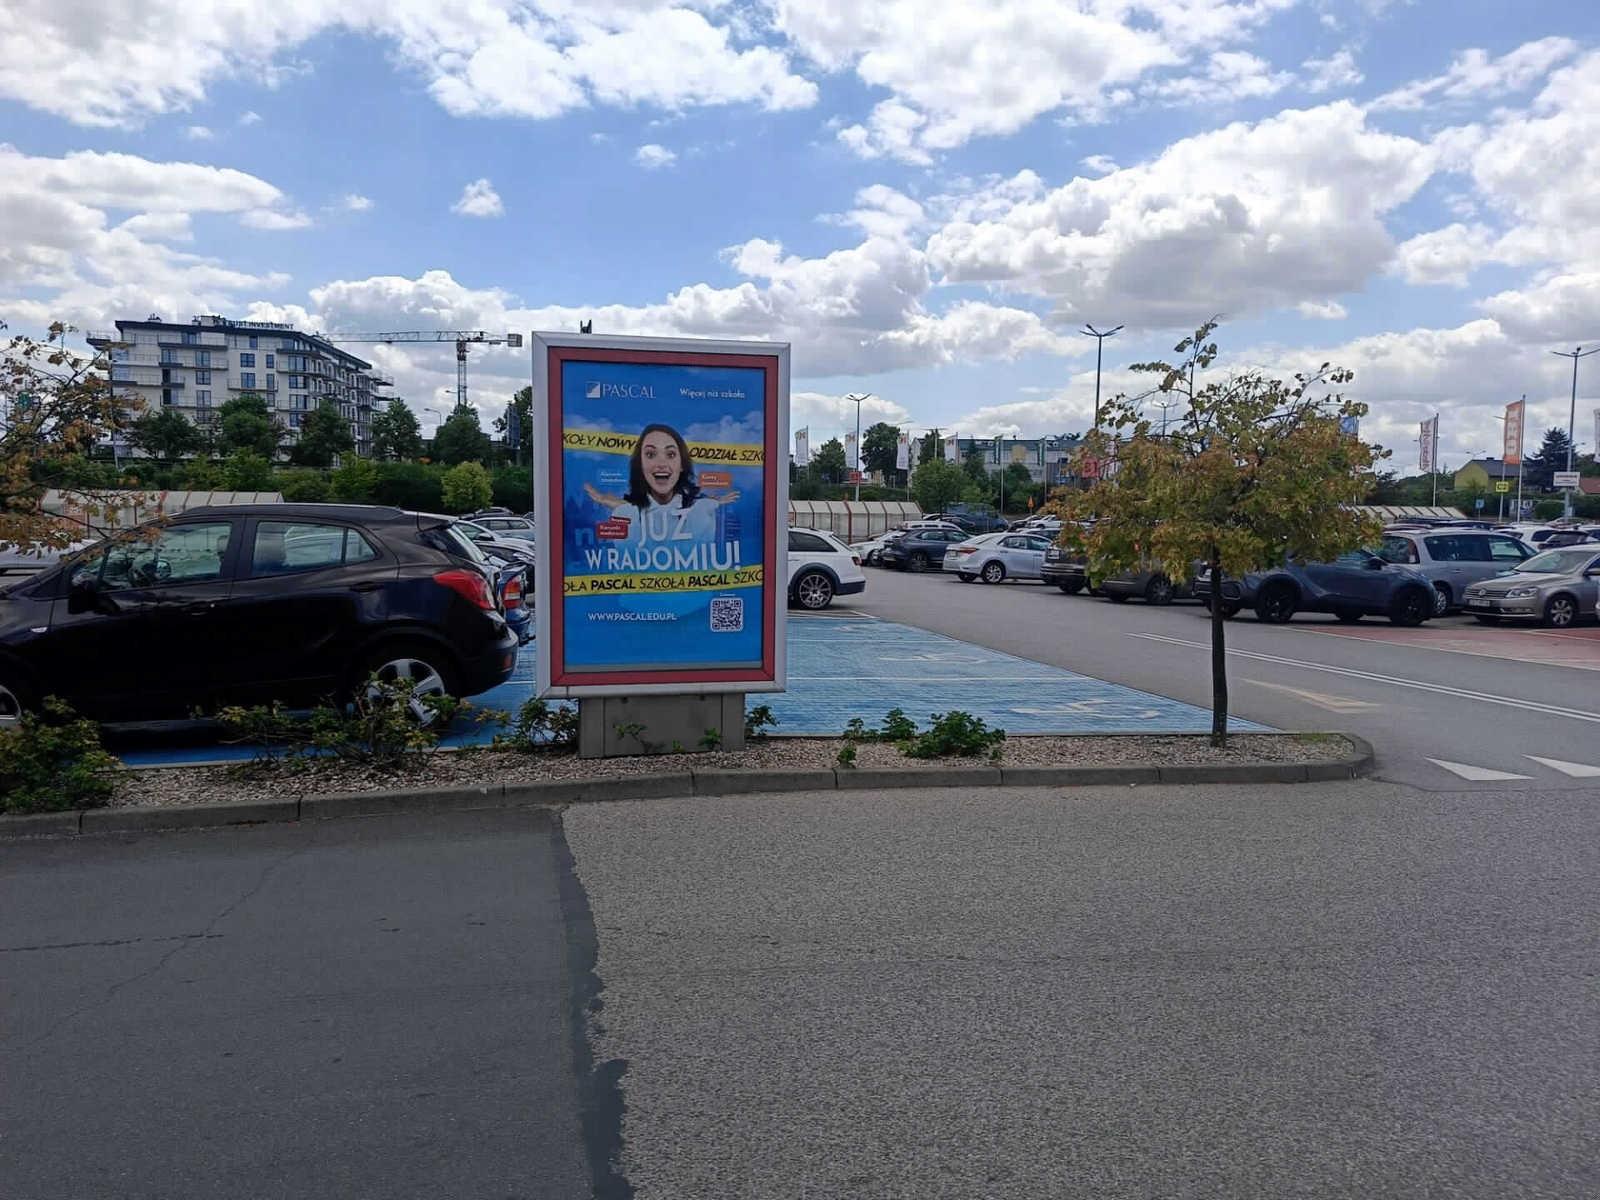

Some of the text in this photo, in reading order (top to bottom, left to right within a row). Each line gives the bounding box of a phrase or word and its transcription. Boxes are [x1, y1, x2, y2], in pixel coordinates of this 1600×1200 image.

[602, 383, 657, 399] PASCAL
[596, 437, 636, 450] NOWY
[688, 446, 737, 461] ODDZIAŁ
[585, 540, 741, 571] W RADOMIU!
[590, 578, 636, 591] PASCAL
[639, 576, 686, 589] SZKOŁA
[687, 573, 730, 587] PASCAL
[588, 612, 677, 621] WWW.PASCAL.EDU.PL
